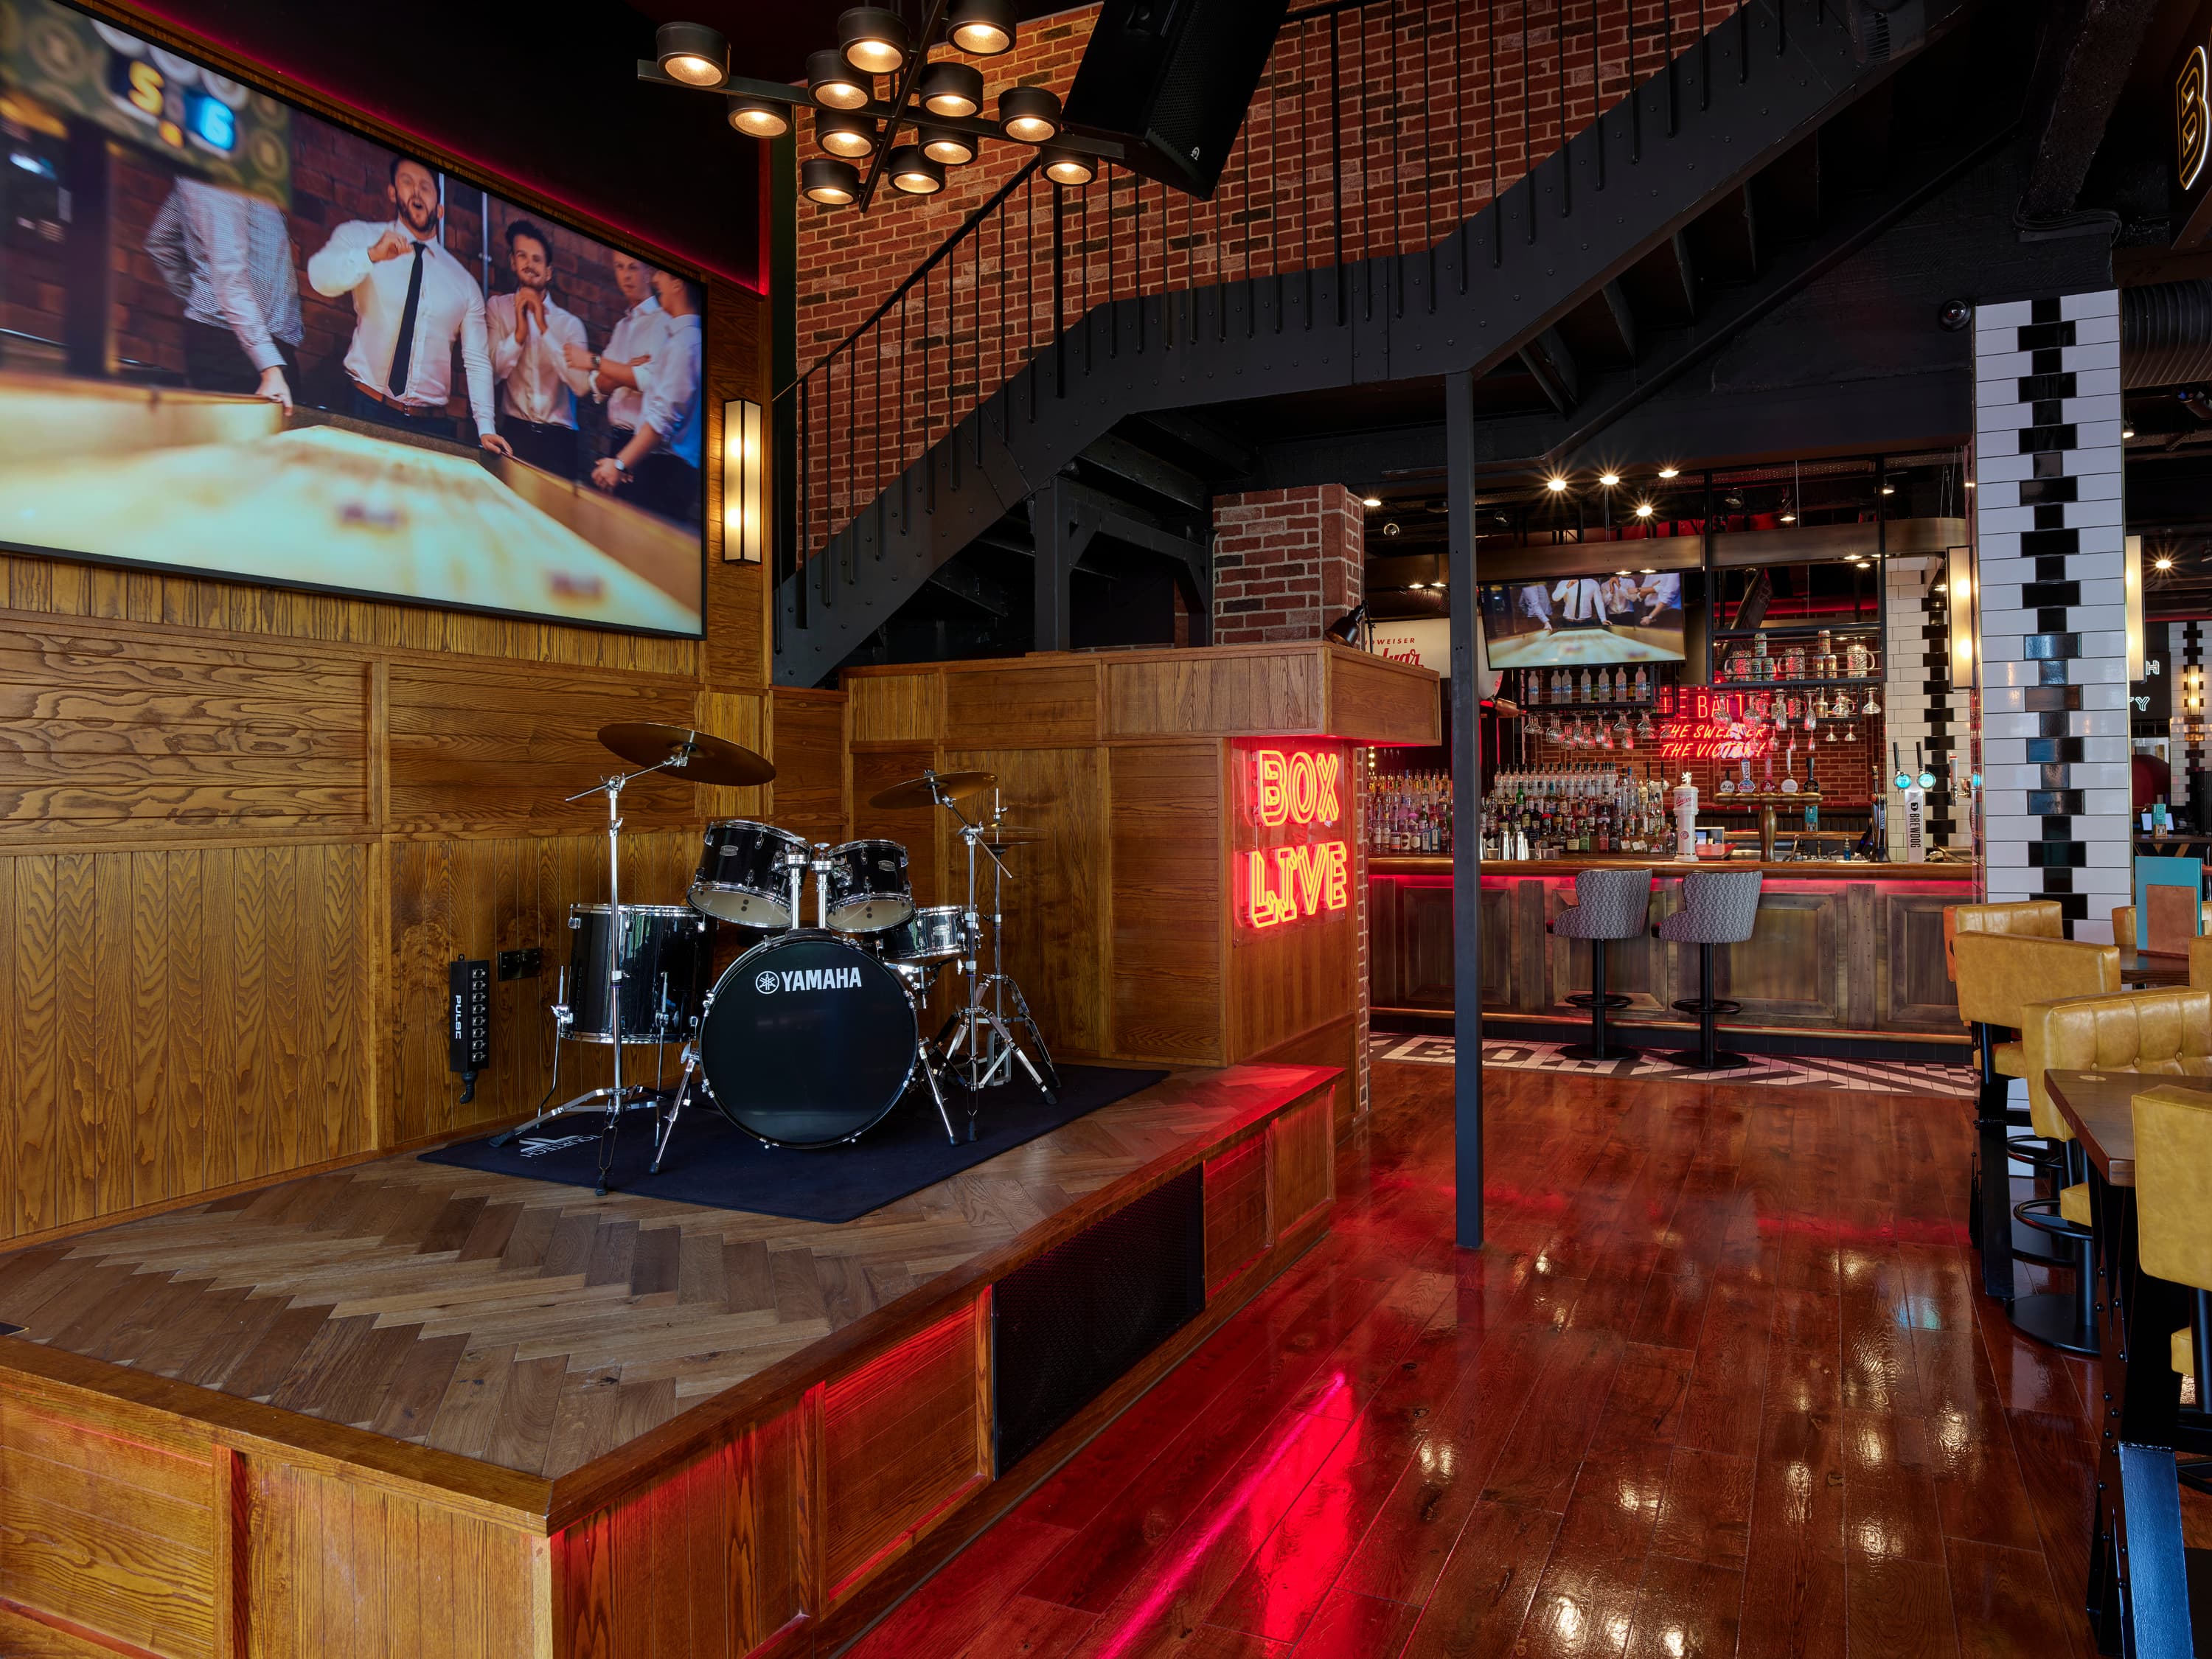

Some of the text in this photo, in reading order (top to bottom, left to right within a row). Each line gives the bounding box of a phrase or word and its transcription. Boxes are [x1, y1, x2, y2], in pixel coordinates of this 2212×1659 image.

[1661, 742, 1694, 757] THE
[1256, 749, 1339, 827] BOX
[1909, 813, 1921, 848] BREWDOG
[1248, 841, 1347, 929] LIVE
[781, 967, 862, 992] YAMAHA
